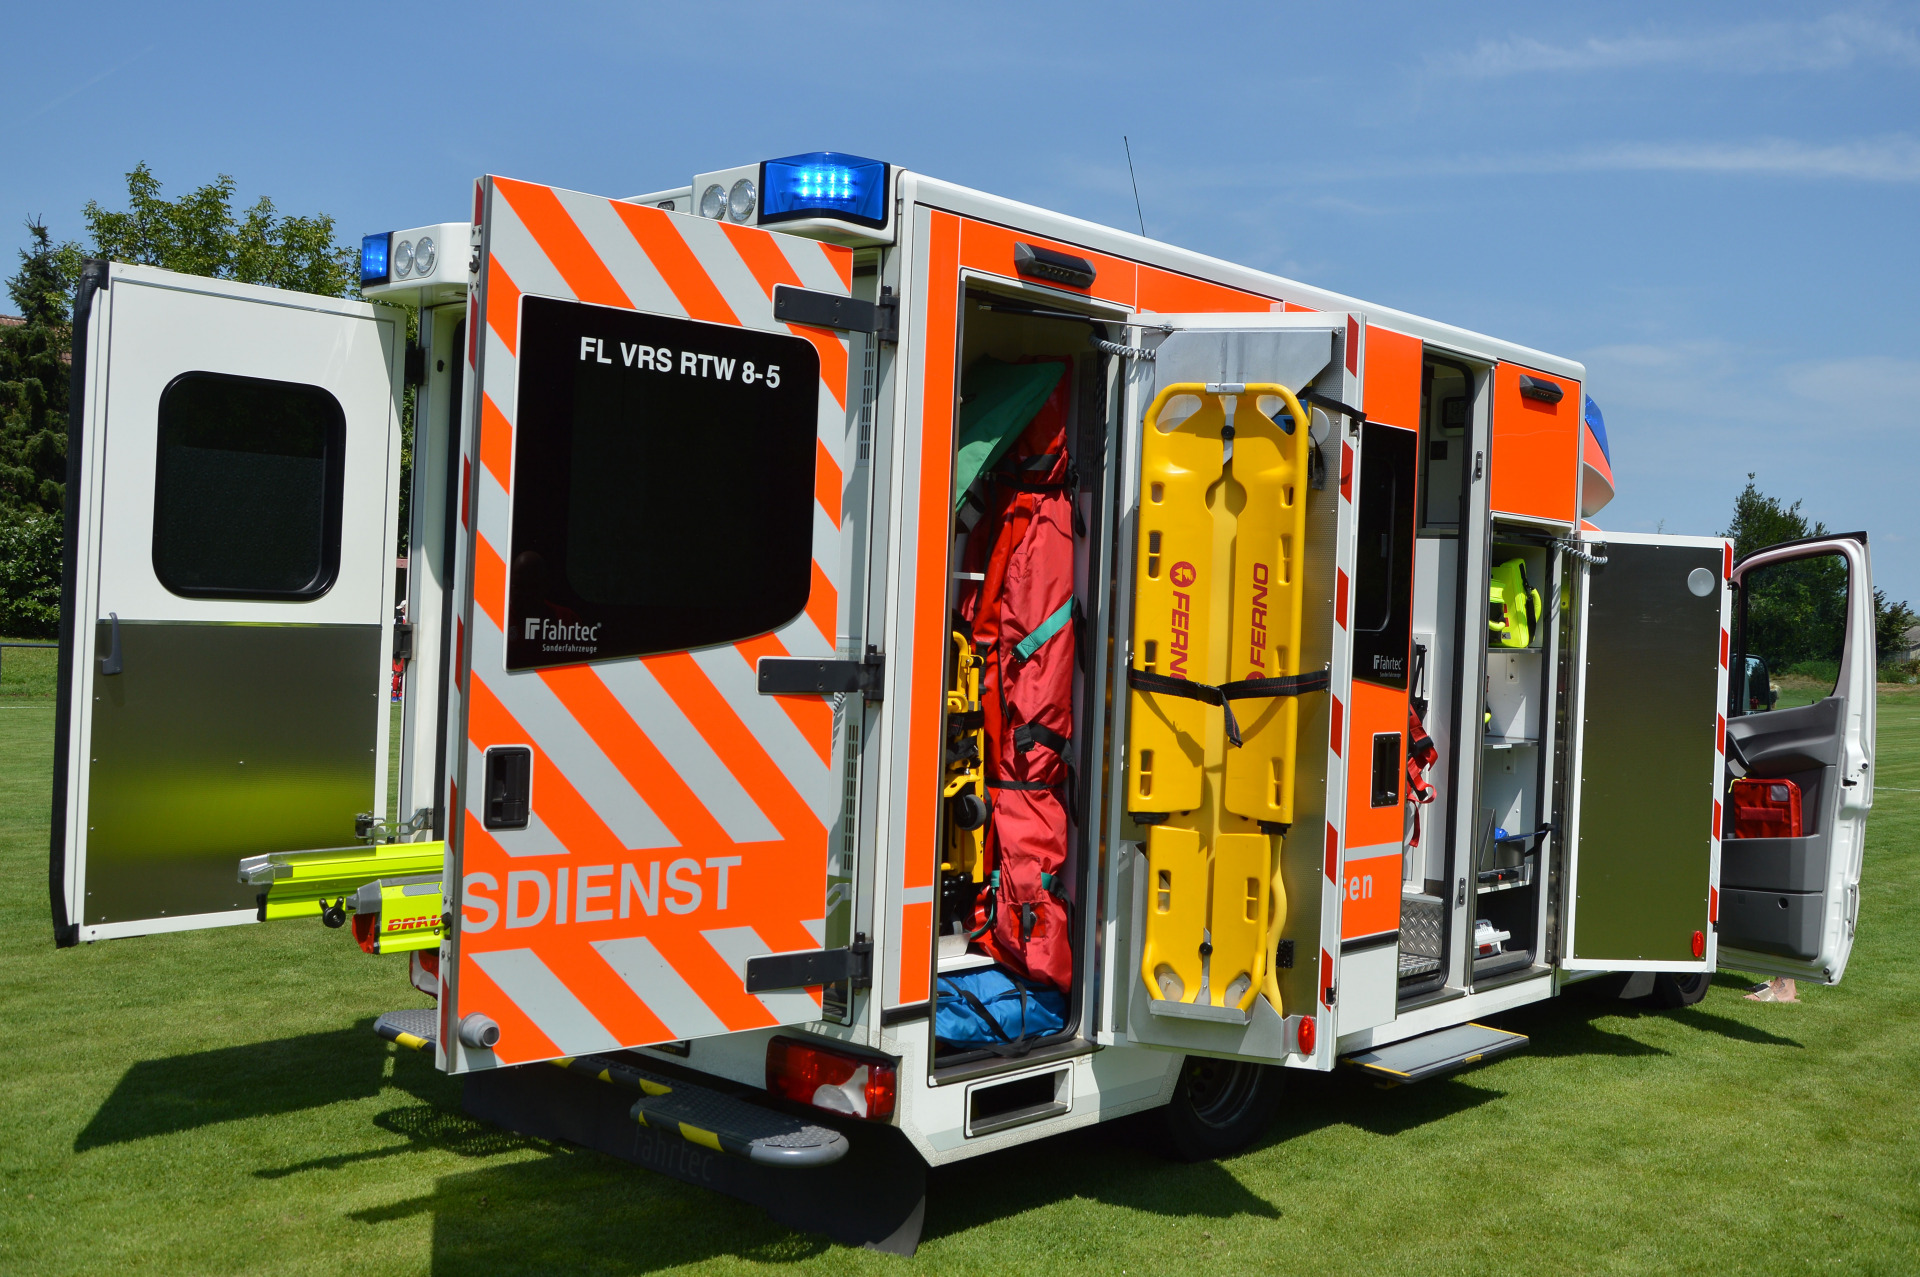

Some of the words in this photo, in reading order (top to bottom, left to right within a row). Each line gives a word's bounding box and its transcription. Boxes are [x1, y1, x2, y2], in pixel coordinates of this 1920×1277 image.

[580, 336, 612, 364] FL
[620, 342, 673, 373] VRS
[680, 351, 736, 381] RTW
[742, 361, 781, 389] 8-5
[543, 618, 598, 642] fahrtec
[1170, 590, 1190, 680] FERN
[1250, 562, 1269, 669] FERNO
[542, 643, 598, 655] Sonderfahrzeuge
[460, 855, 742, 934] SDIENST
